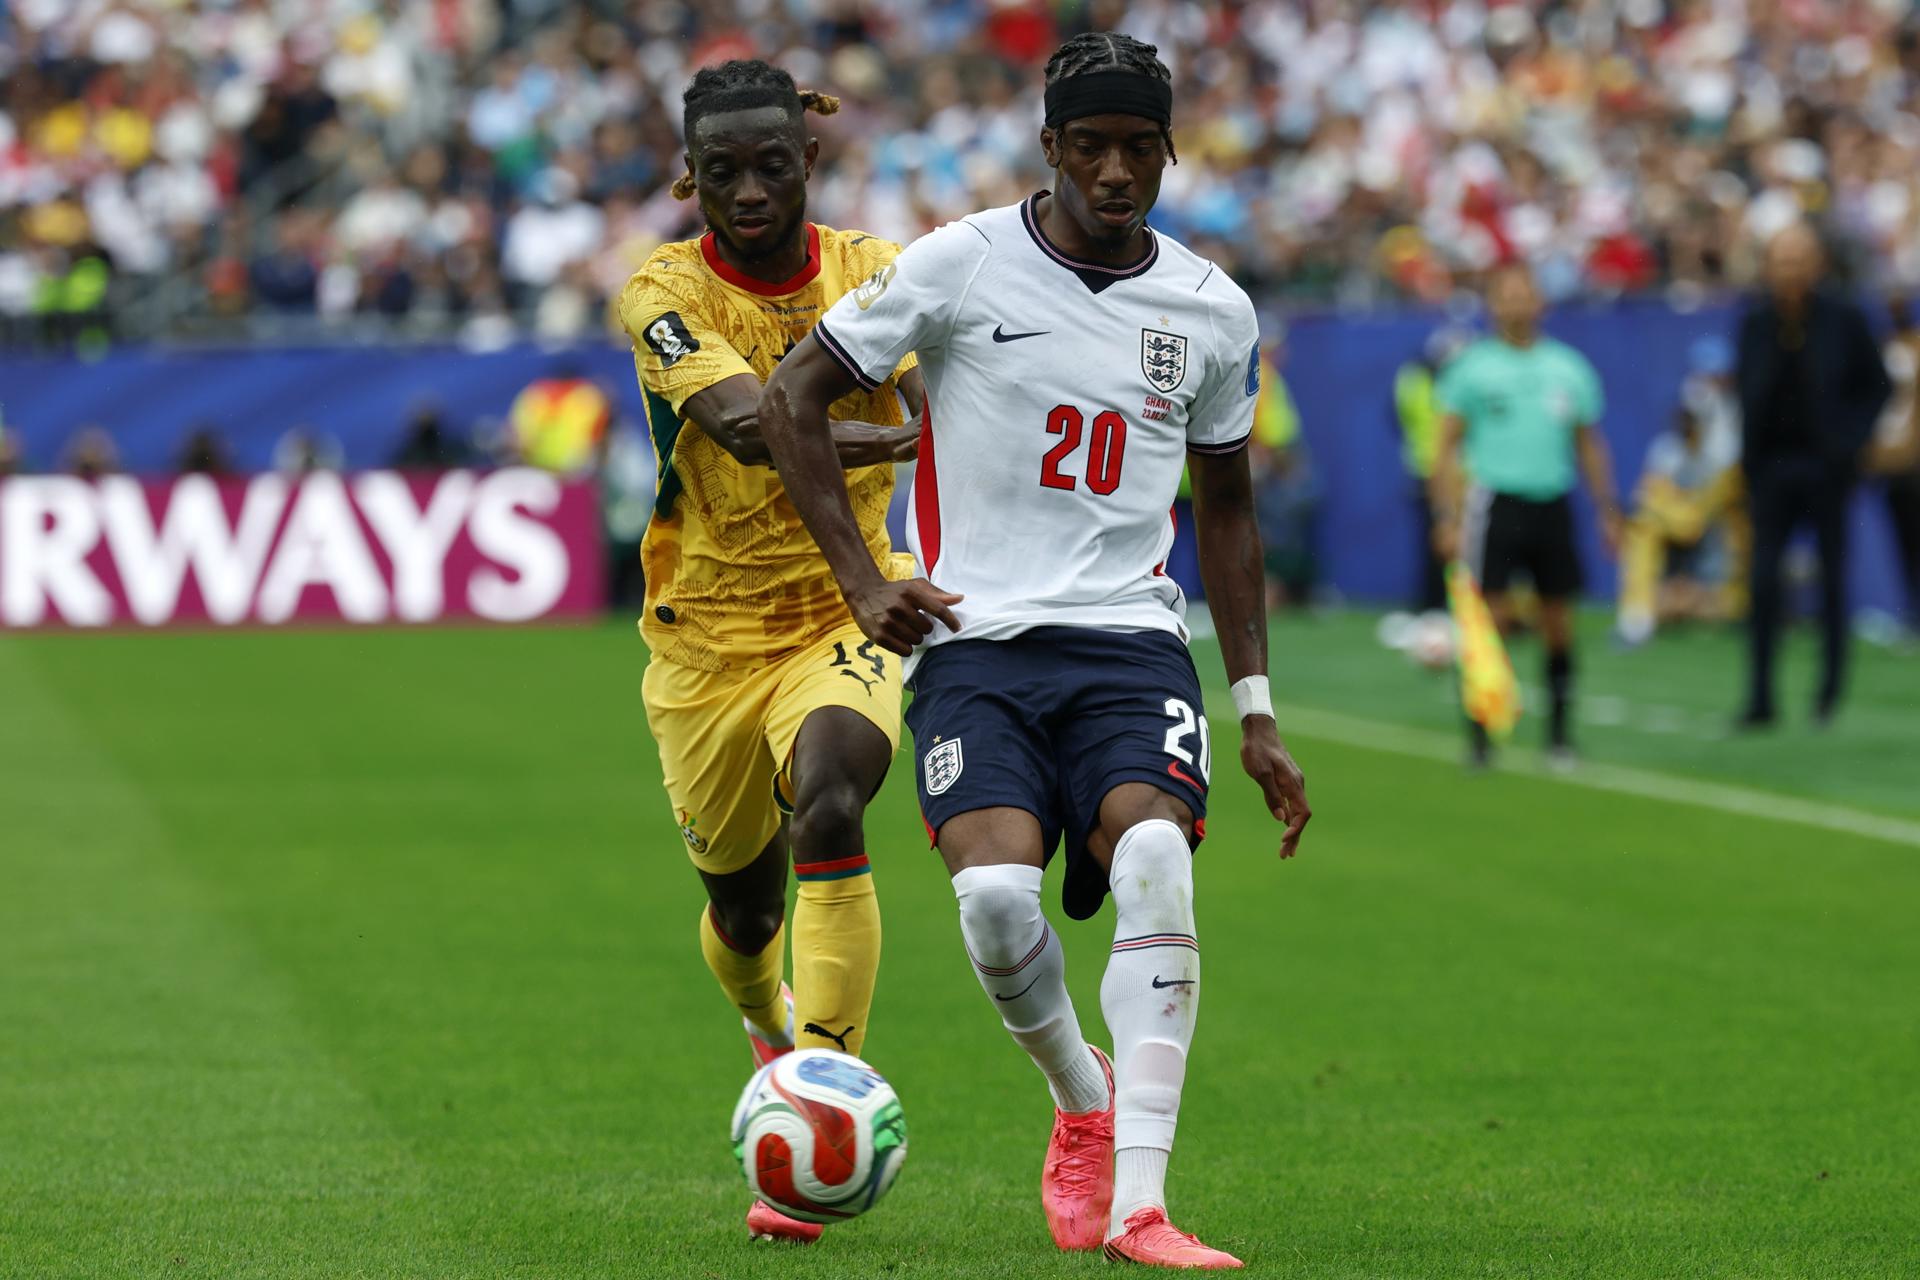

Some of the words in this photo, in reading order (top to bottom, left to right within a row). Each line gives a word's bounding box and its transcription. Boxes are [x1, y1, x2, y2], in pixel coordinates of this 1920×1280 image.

[792, 303, 818, 313] GHANA
[1144, 396, 1172, 412] GHANA
[1040, 403, 1127, 496] 20
[0, 467, 571, 628] RWAYS
[829, 640, 886, 682] 14
